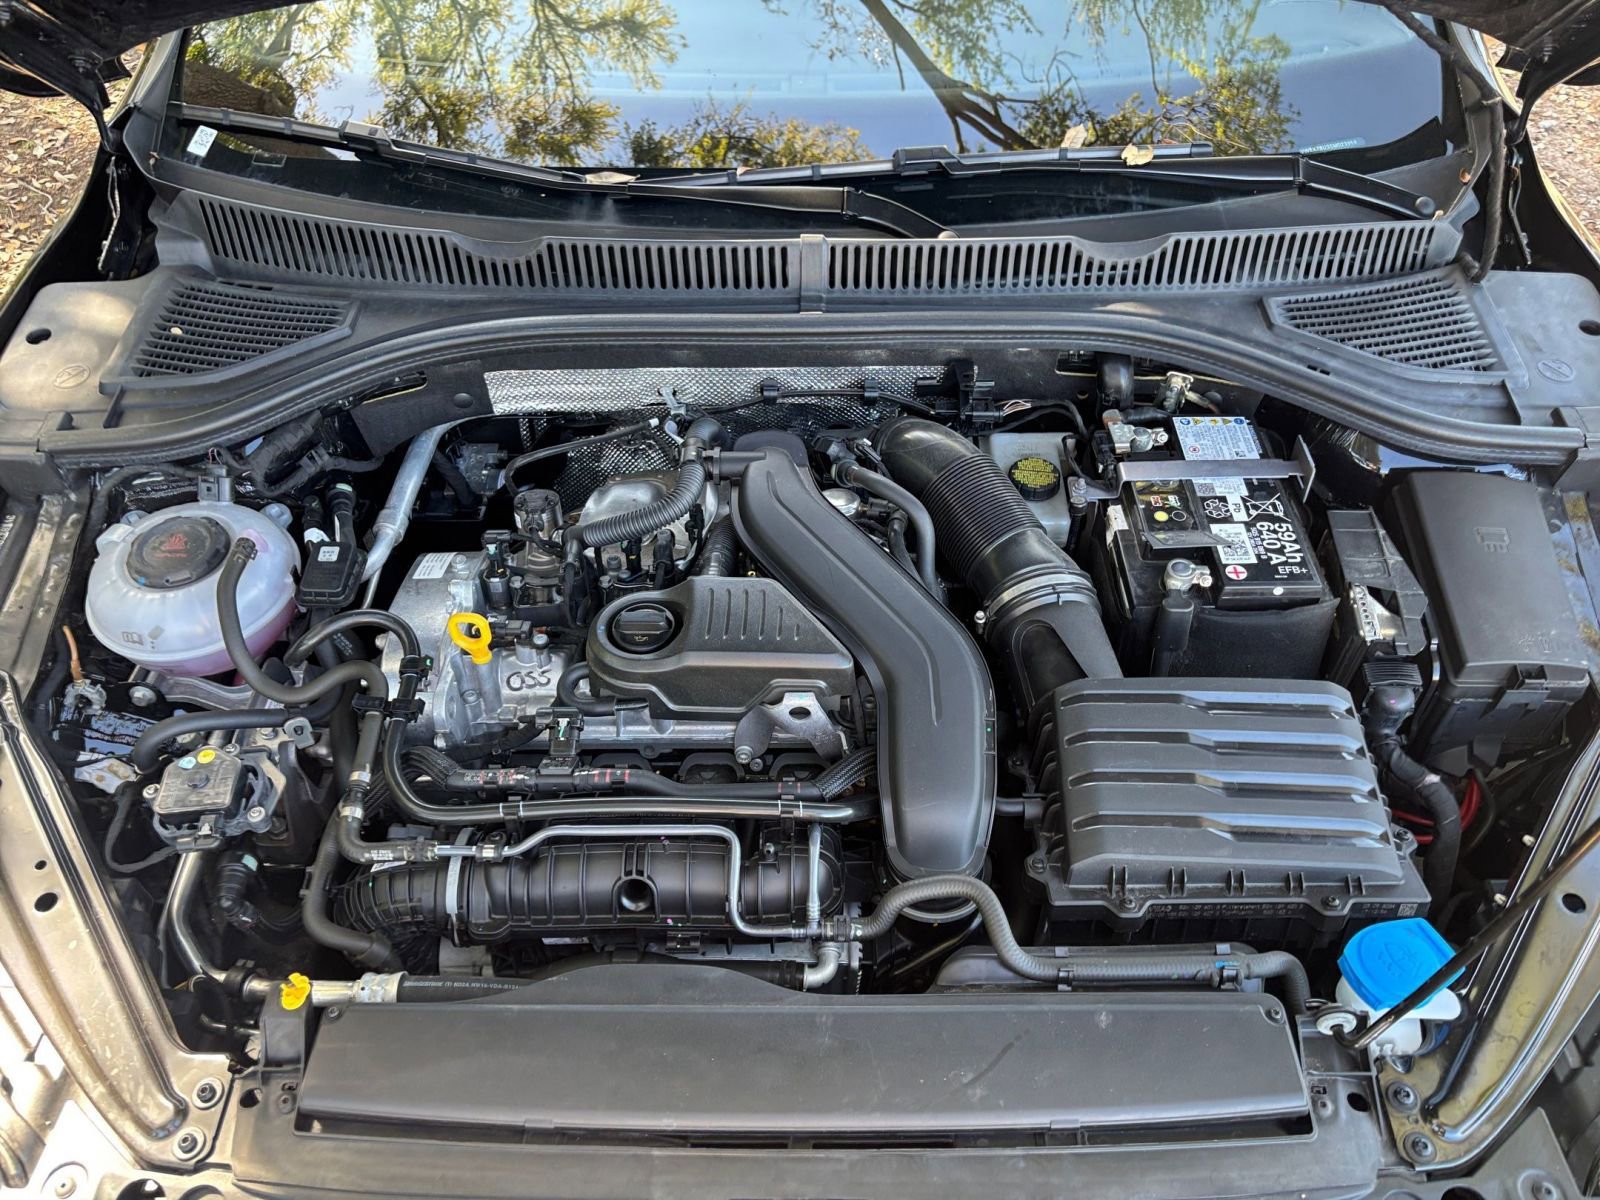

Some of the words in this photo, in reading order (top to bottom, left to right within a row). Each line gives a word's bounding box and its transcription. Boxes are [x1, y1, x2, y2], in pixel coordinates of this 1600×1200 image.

[1256, 521, 1281, 549] 640
[1275, 523, 1303, 563] 59Ah
[1267, 552, 1287, 565] A
[1278, 565, 1308, 574] EFB+
